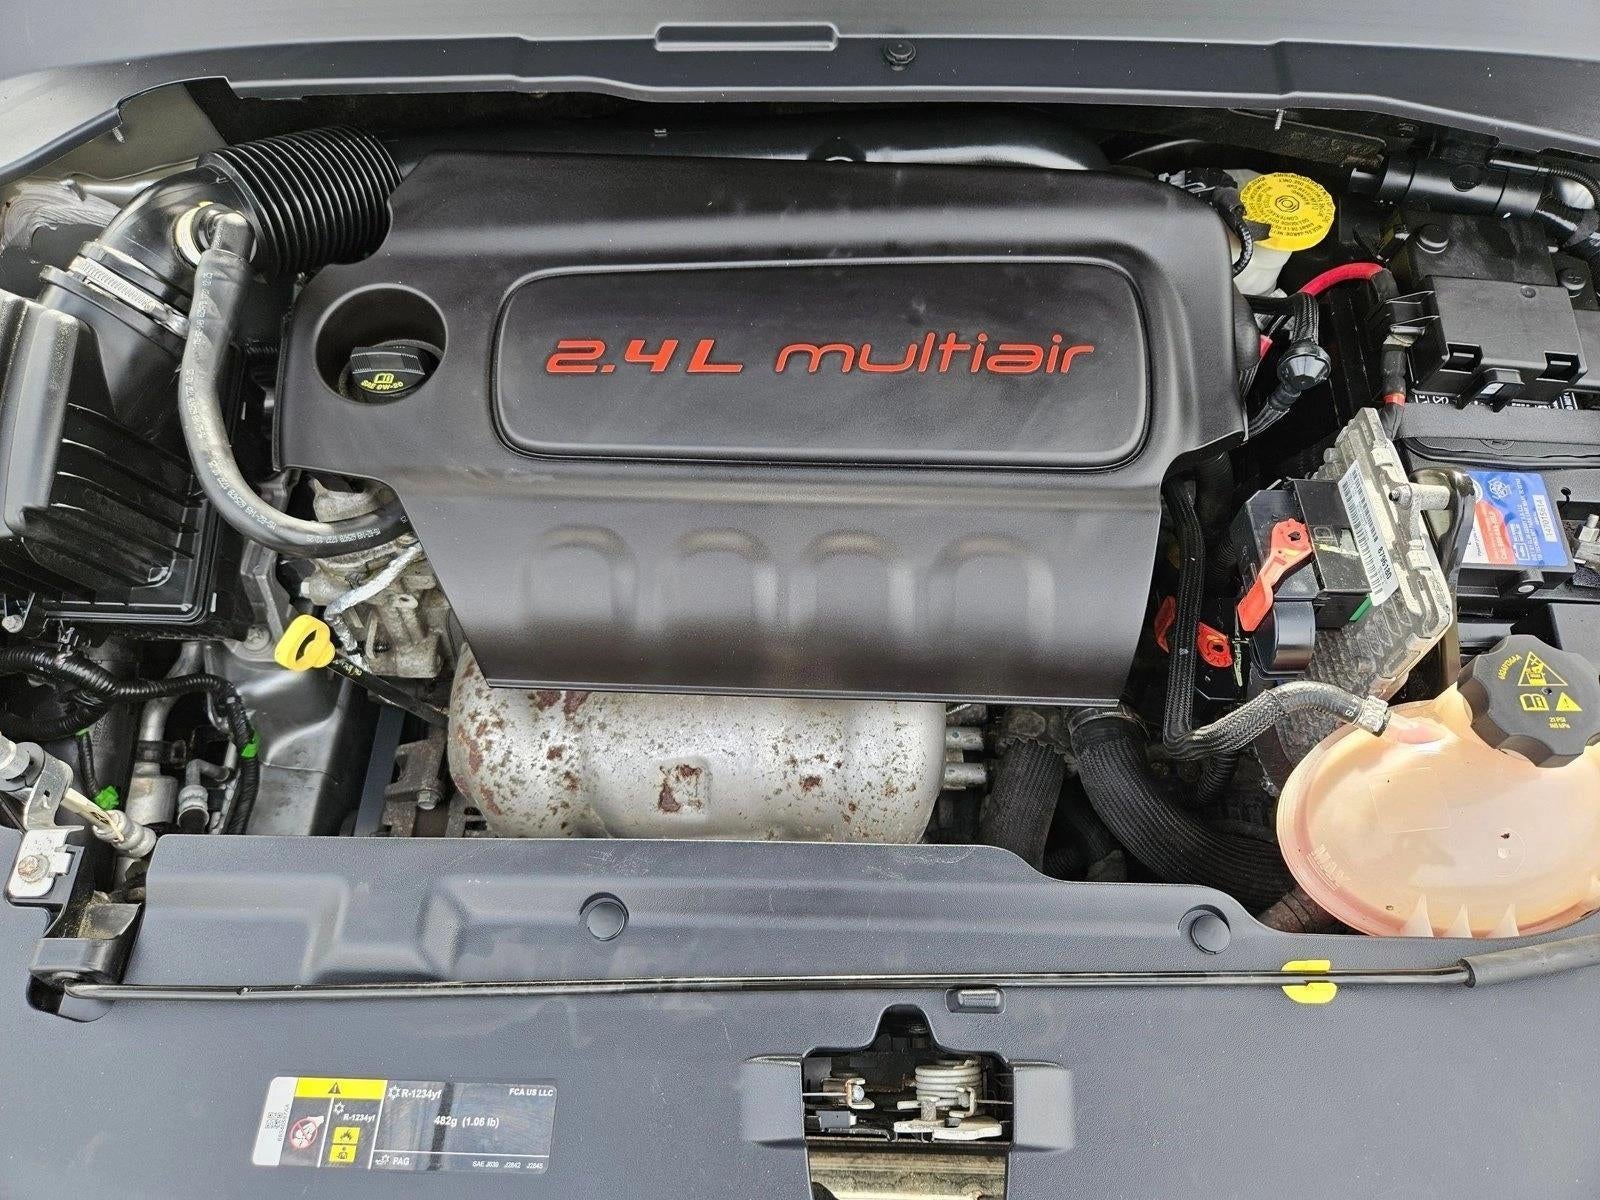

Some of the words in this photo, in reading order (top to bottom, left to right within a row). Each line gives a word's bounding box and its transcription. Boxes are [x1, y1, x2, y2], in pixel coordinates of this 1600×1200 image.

[775, 332, 1095, 374] multiair
[402, 1088, 442, 1100] R-1234yf
[509, 1088, 526, 1096] FCA
[526, 1088, 538, 1096] US
[538, 1089, 554, 1097] LLC
[342, 1114, 376, 1123] R-1234yf
[434, 1115, 458, 1128] 482g
[392, 1156, 410, 1166] PAG
